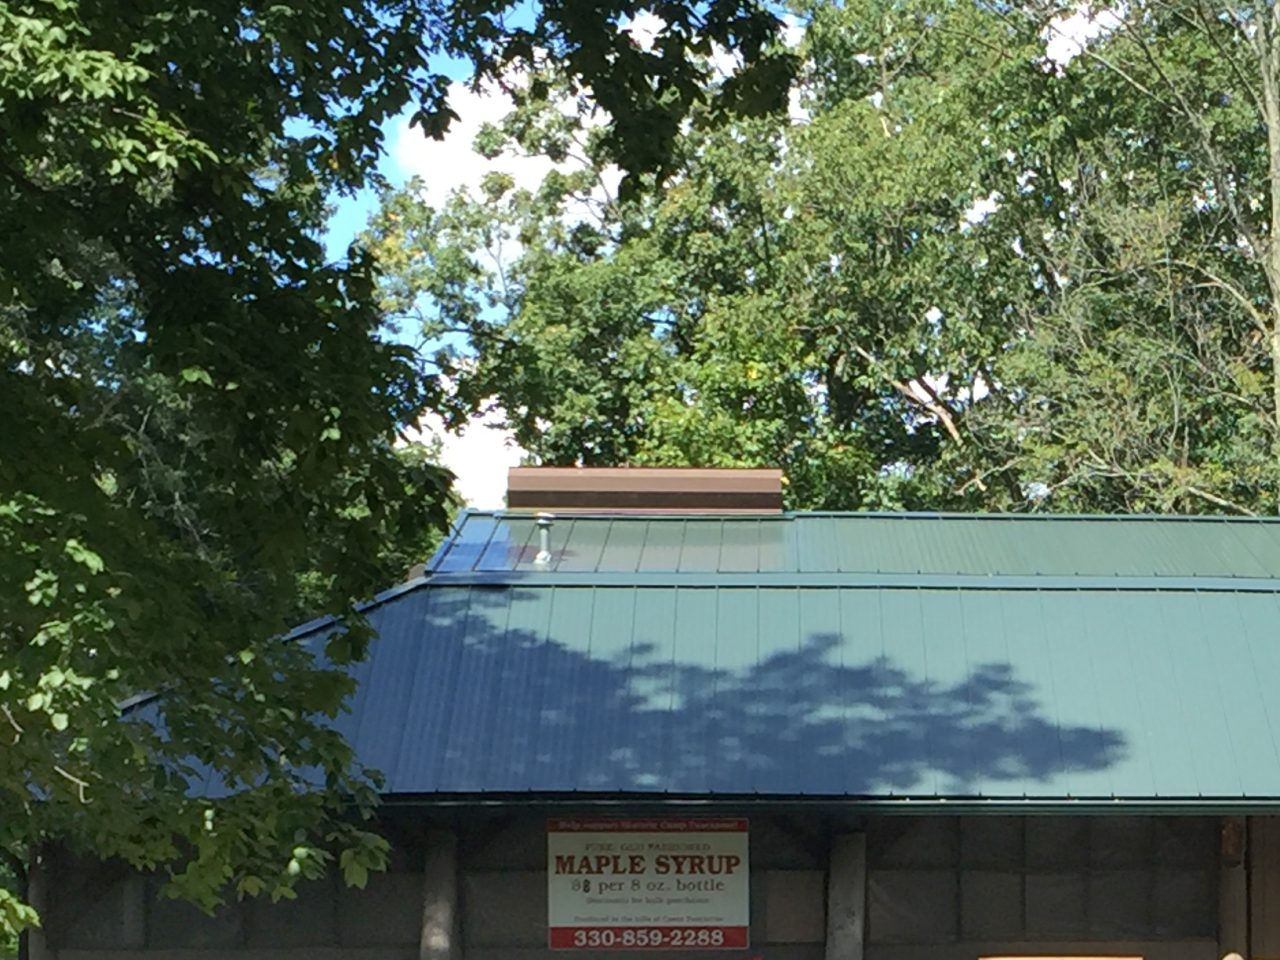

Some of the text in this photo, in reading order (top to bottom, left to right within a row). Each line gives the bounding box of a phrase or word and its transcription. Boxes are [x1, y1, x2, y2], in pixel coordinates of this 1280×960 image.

[555, 855, 741, 874] MAPLE SYRUP
[598, 881, 625, 895] per
[630, 879, 641, 891] 8
[646, 881, 671, 892] oz.
[676, 879, 725, 892] bottle
[574, 930, 724, 946] 330-859-2288
